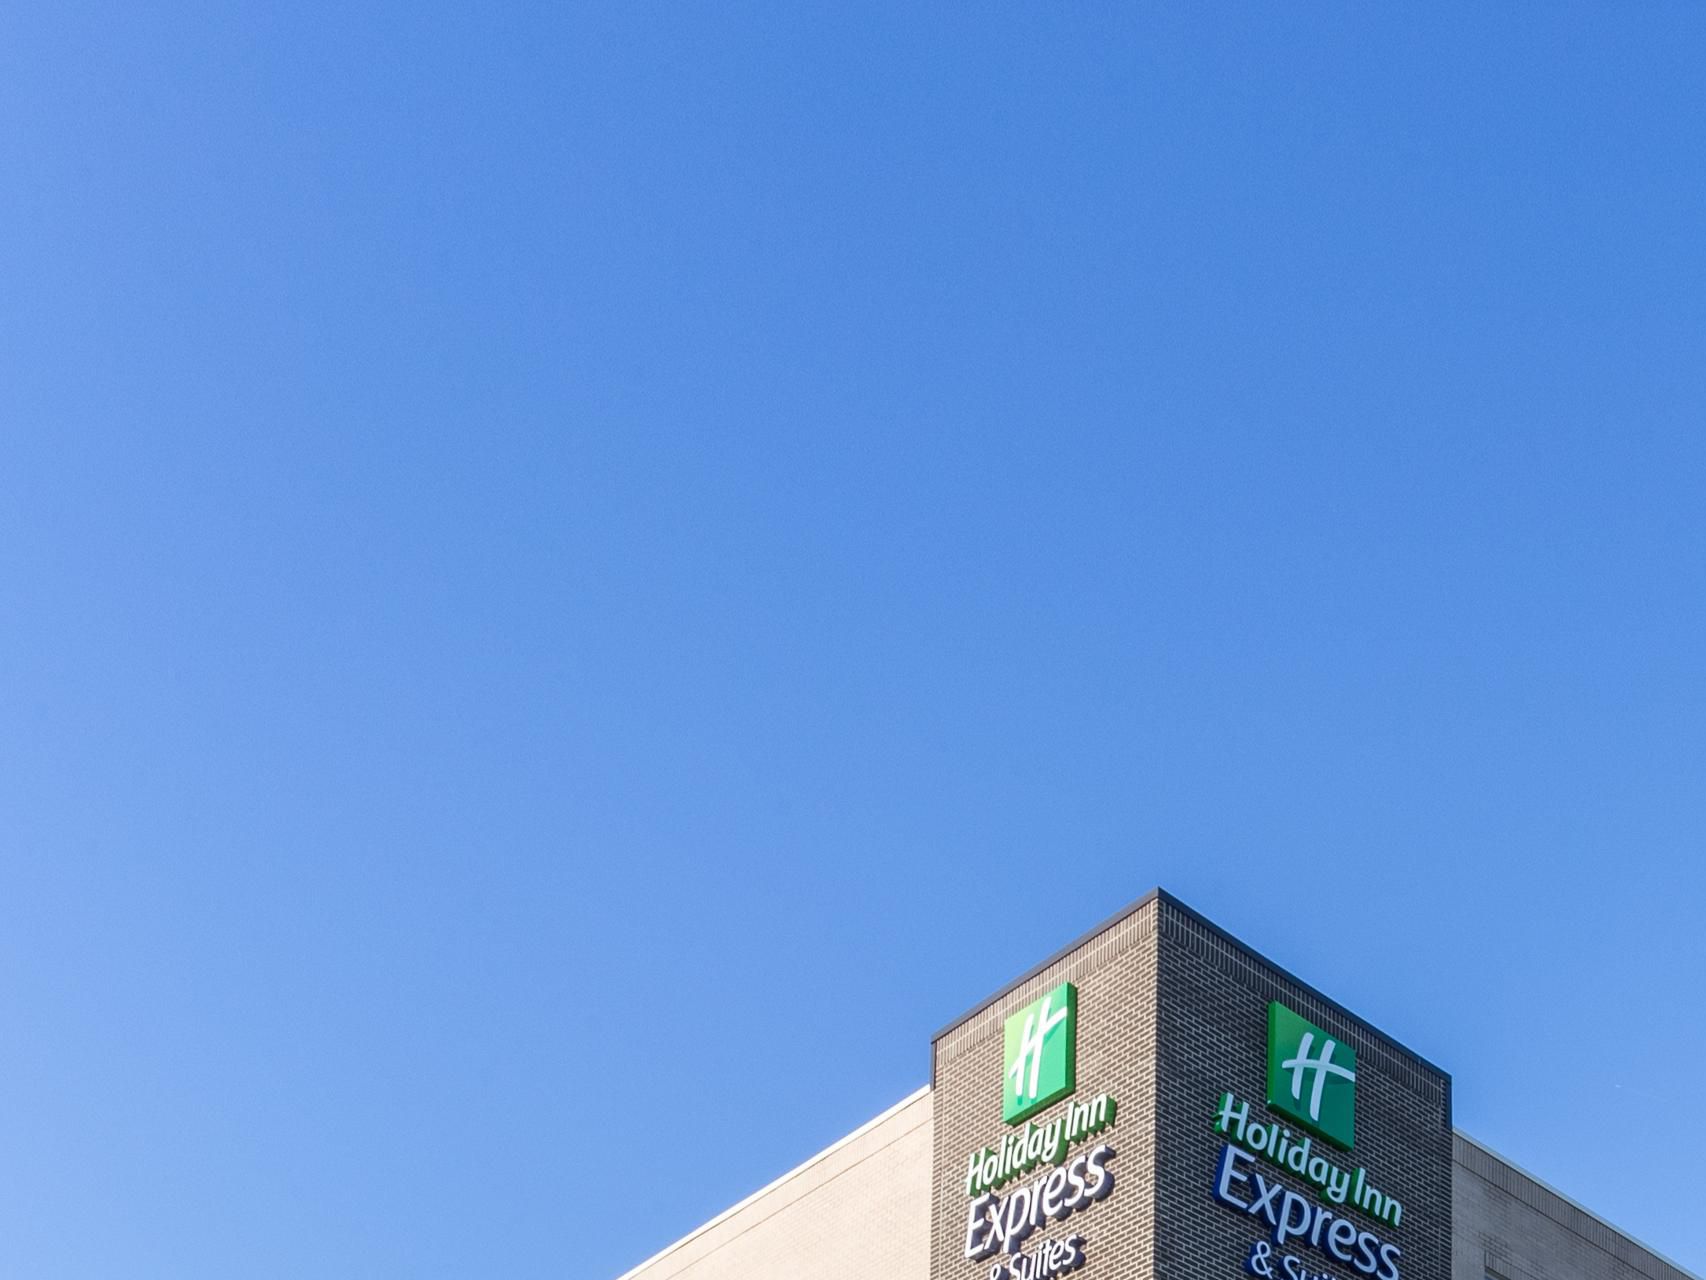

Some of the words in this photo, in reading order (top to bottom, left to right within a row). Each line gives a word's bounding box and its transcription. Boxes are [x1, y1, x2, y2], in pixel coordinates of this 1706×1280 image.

[966, 1118, 1062, 1196] Holiday
[1064, 1093, 1107, 1141] Inn
[1218, 1092, 1350, 1204] Holiday
[1353, 1167, 1402, 1227] Inn
[965, 1144, 1107, 1258] Express
[1250, 1240, 1273, 1280] &
